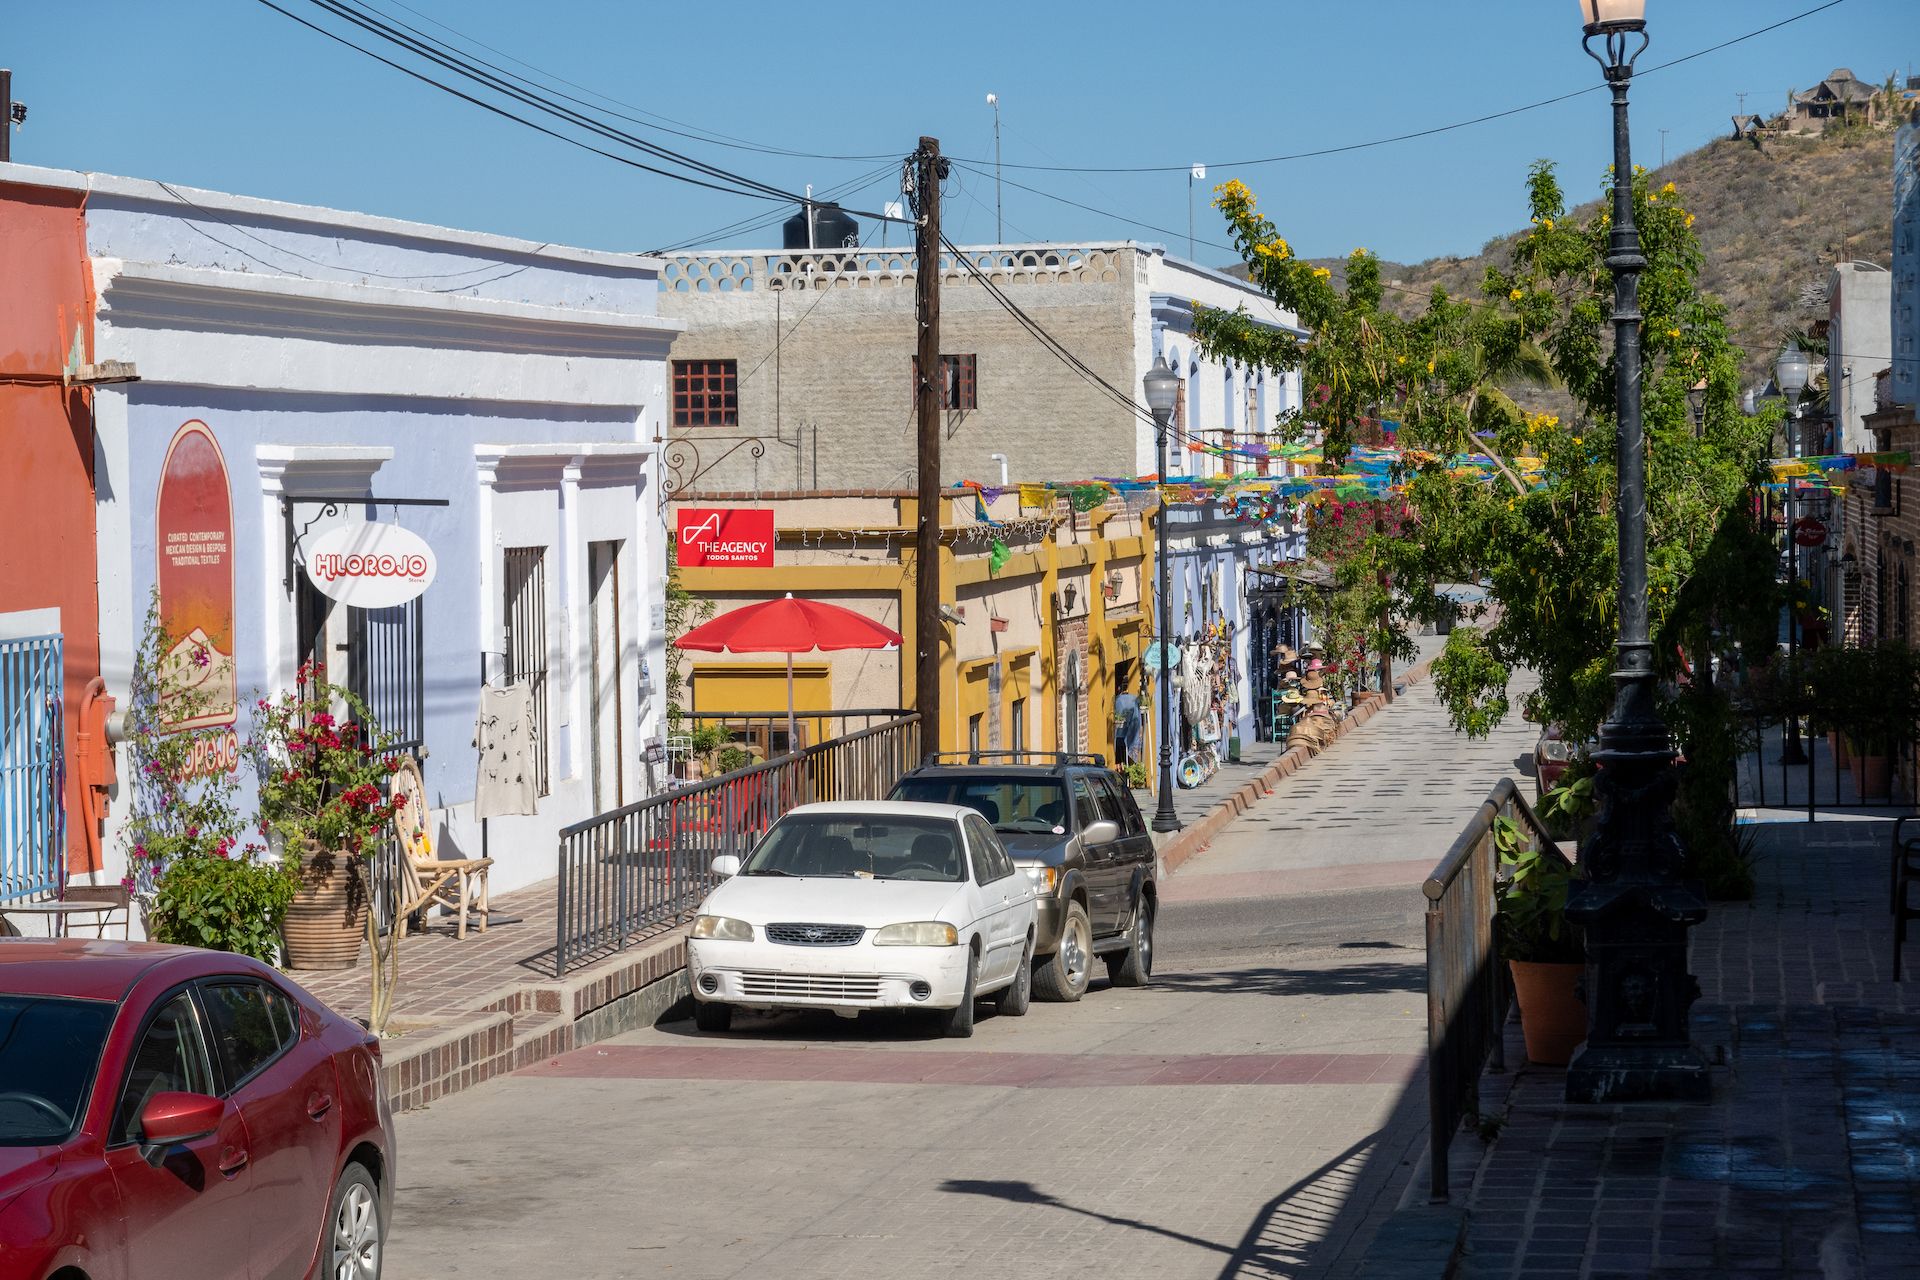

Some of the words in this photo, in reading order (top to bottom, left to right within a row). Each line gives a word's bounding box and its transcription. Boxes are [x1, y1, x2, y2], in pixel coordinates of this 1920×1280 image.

[168, 532, 188, 543] CURATED
[189, 531, 225, 542] CONTEMPORARY
[165, 544, 185, 555] MEXICAN
[186, 543, 203, 554] DESIGN
[207, 543, 227, 553] BESPOKE
[172, 556, 200, 567] TRADITIONAL
[200, 555, 220, 565] TEXTILES
[315, 554, 427, 582] HILOROJO
